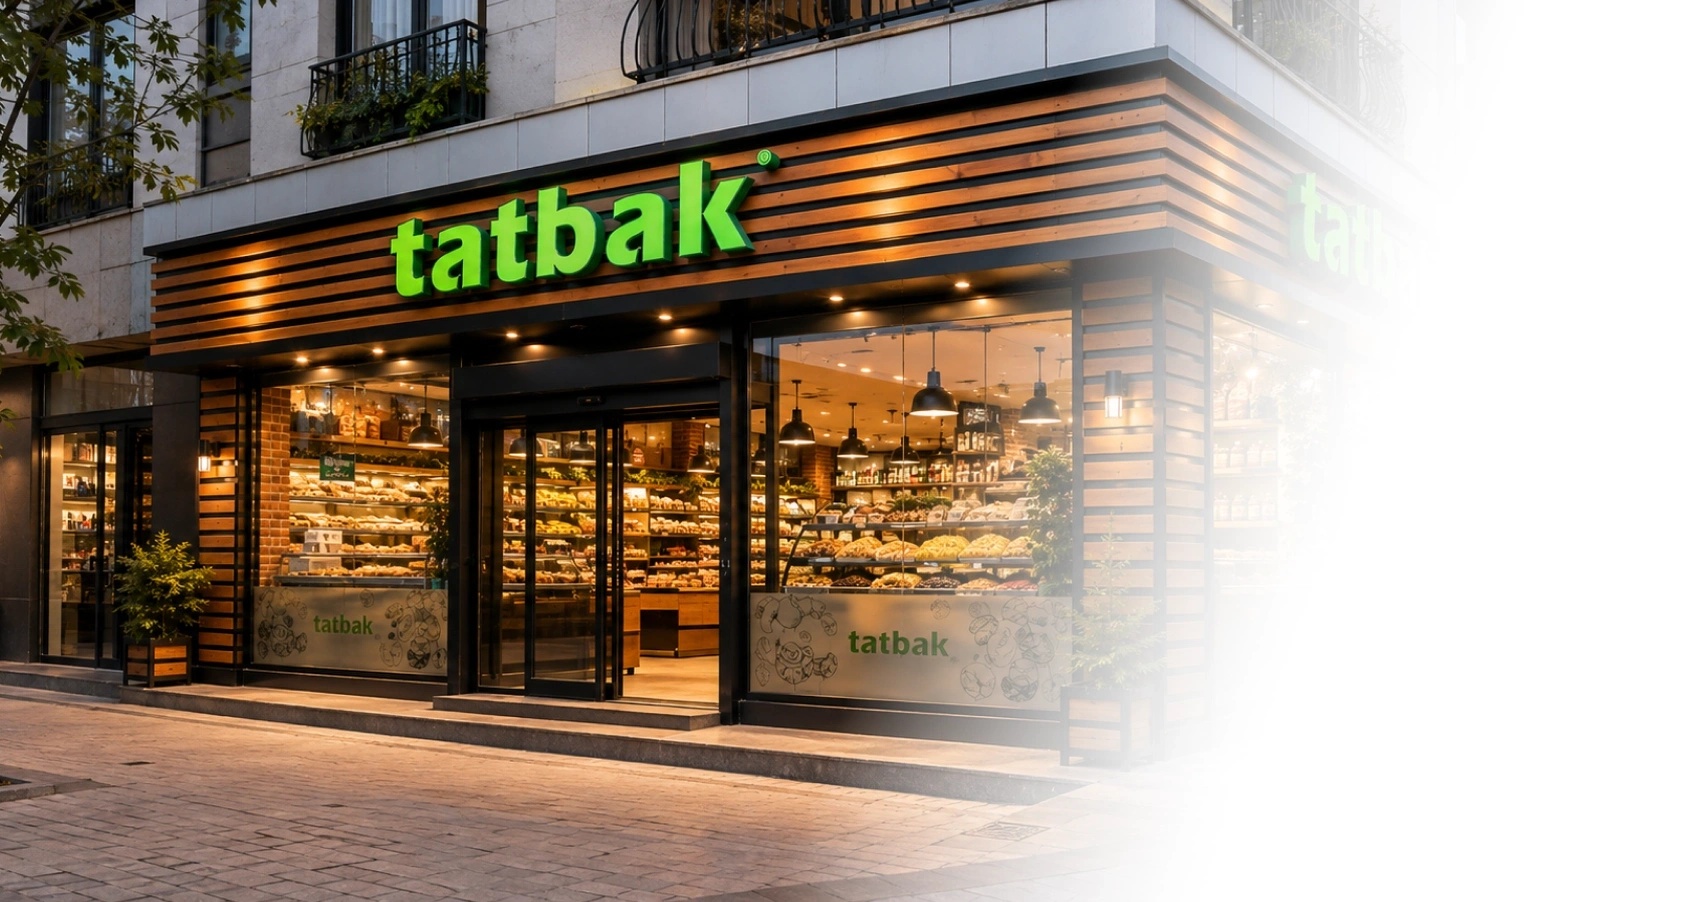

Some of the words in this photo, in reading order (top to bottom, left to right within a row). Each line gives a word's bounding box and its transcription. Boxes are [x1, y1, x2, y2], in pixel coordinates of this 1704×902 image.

[390, 159, 755, 298] tatbak
[1289, 172, 1395, 297] tatb
[313, 614, 373, 635] tatbak
[848, 630, 949, 657] tatbak
